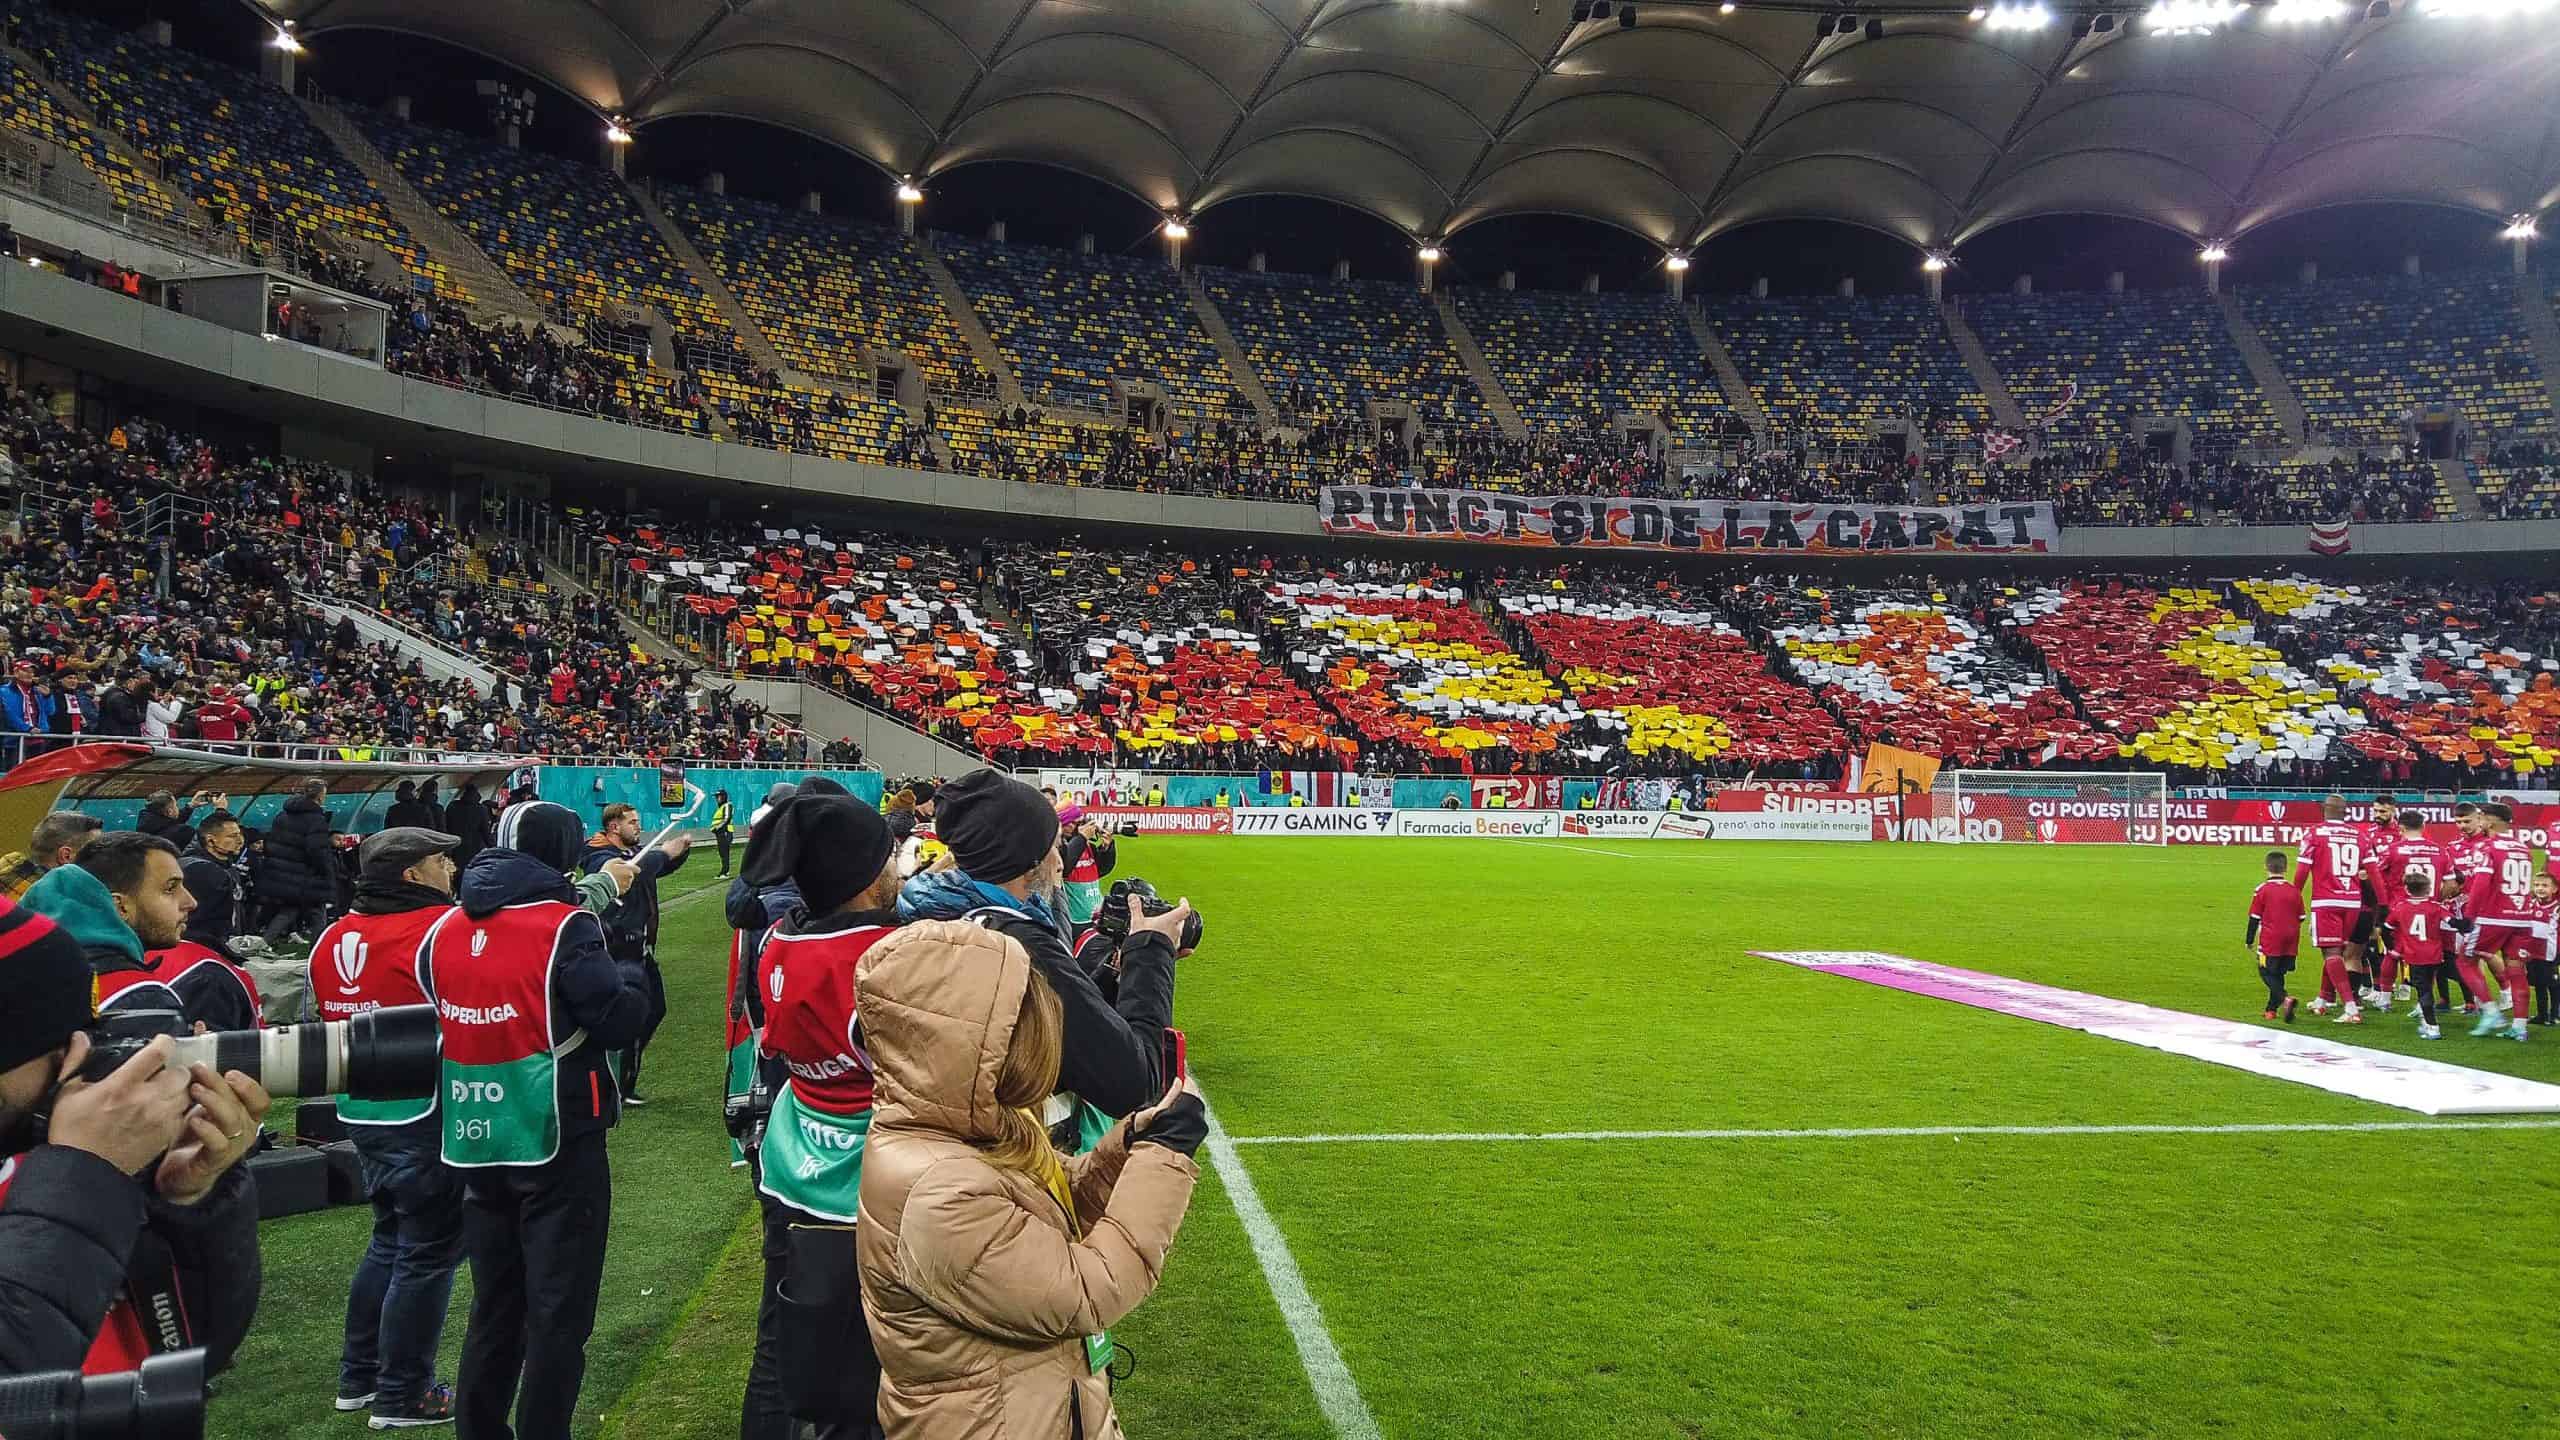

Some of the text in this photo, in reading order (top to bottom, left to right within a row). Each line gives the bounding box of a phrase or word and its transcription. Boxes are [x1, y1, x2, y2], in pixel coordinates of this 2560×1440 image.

[1332, 489, 2035, 548] PUNCT SI DE LA CAPAT
[1763, 793, 1906, 816] SUPERBET
[2029, 802, 2055, 817] CU
[2164, 804, 2207, 819] TALE
[1237, 814, 1279, 830] 7777
[1284, 813, 1367, 830] GAMING
[1404, 817, 1544, 835] Farmacia Beneva
[1576, 813, 1649, 827] Regata.ro
[2126, 824, 2156, 841] CU
[2328, 843, 2360, 877] 19
[2501, 859, 2531, 896] 99
[2409, 913, 2427, 942] 4
[324, 1000, 381, 1013] SUPERLIGA
